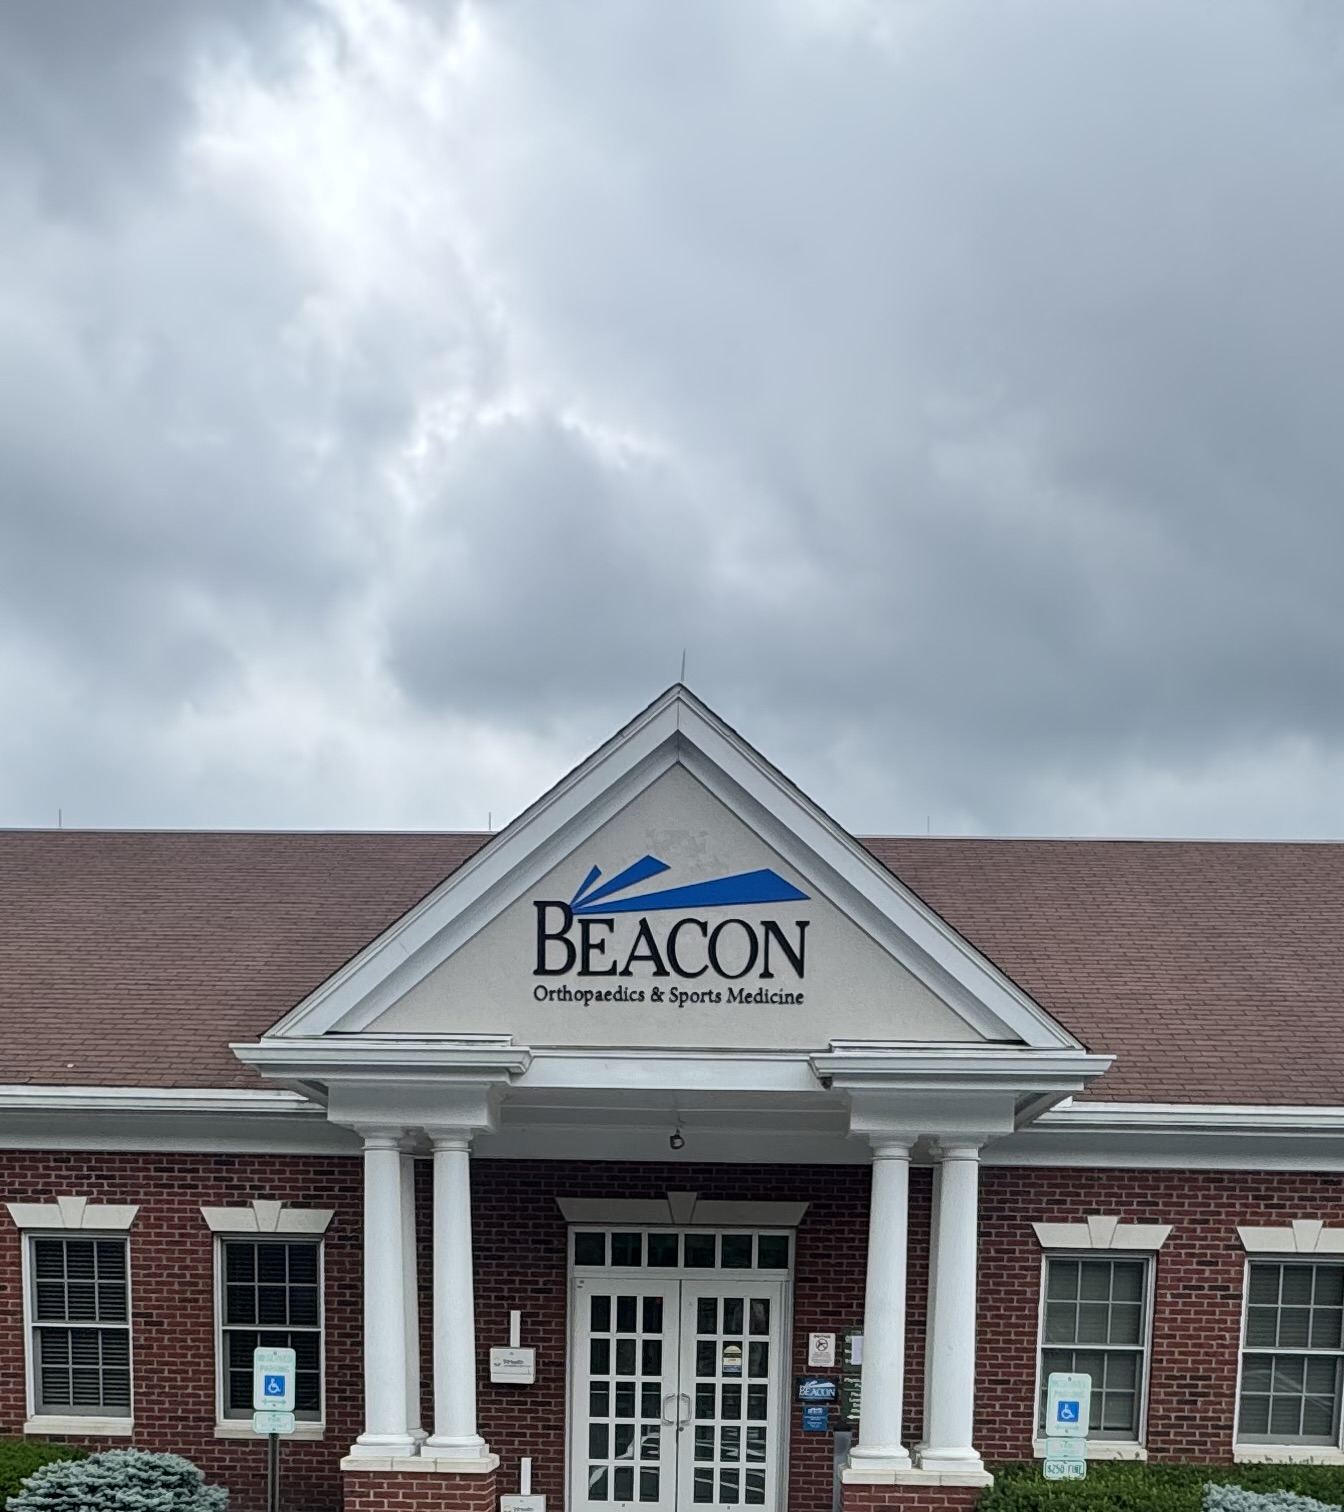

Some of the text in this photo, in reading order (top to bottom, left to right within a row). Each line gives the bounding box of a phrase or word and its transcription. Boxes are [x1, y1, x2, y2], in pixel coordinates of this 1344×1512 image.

[532, 900, 811, 979] BEACON
[533, 985, 805, 1008] Orthopaedics & Sports Medicine
[799, 1385, 836, 1396] BEACON
